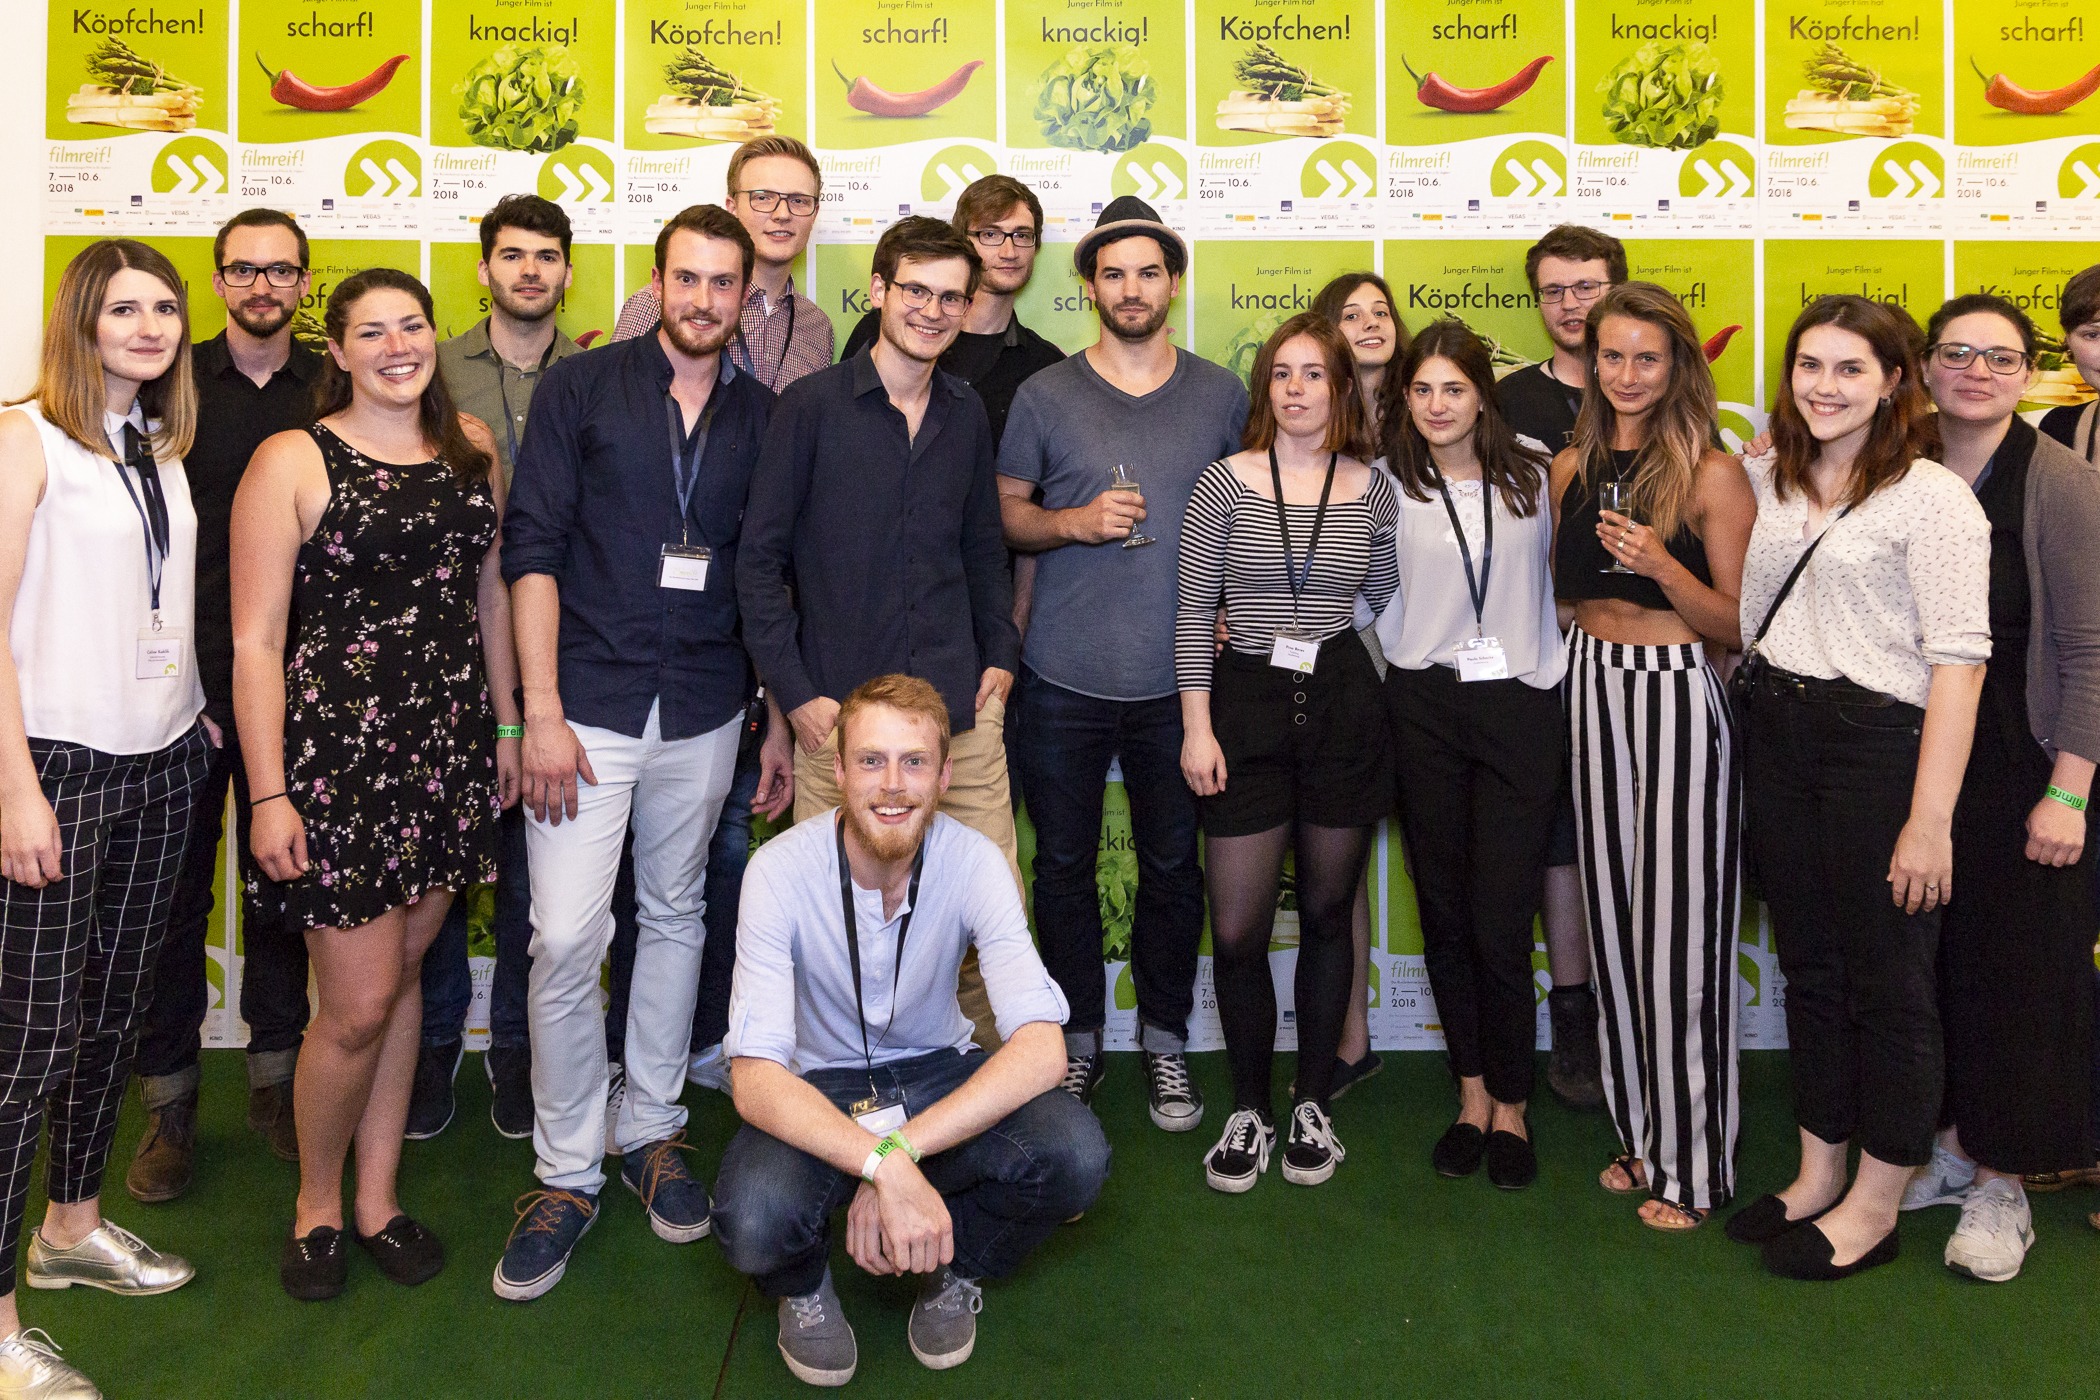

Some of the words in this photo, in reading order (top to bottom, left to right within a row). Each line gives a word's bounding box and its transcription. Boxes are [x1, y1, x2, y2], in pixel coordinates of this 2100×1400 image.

[685, 2, 711, 11] Junger
[713, 2, 731, 10] Film
[733, 2, 746, 10] hat
[877, 1, 903, 10] Junger
[905, 1, 923, 9] Film
[1067, 0, 1093, 9] Junger
[73, 8, 204, 34] Köpfchen!
[287, 11, 373, 37] scharf!
[1220, 14, 1350, 41] Köpfchen!
[1432, 13, 1517, 39] scharf!
[1611, 13, 1717, 44] knackig!
[1789, 14, 1919, 41] Köpfchen!
[2000, 15, 2083, 41] scharf!
[469, 14, 577, 47] knackig!
[650, 18, 781, 45] Köpfchen!
[862, 17, 948, 43] scharf!
[1042, 16, 1148, 47] knackig!
[49, 146, 112, 164] filmreif!
[241, 150, 305, 167] filmreif!
[433, 153, 497, 171] filmreif!
[1009, 154, 1072, 171] filmreif!
[1199, 152, 1262, 169] filmreif!
[1388, 151, 1451, 169] filmreif!
[1577, 151, 1639, 168] filmreif!
[1767, 151, 1830, 169] filmreif!
[627, 156, 691, 174] filmreif!
[49, 184, 74, 193] 2018
[241, 187, 267, 196] 2018
[432, 191, 459, 200] 2018
[1199, 190, 1225, 199] 2018
[1389, 189, 1414, 198] 2018
[1577, 188, 1602, 197] 2018
[1767, 188, 1793, 198] 2018
[1956, 189, 1982, 198] 2018
[627, 194, 653, 203] 2018
[819, 193, 844, 202] 2018
[327, 265, 344, 274] Film
[1256, 266, 1283, 276] Junger
[1284, 266, 1302, 275] Film
[1303, 267, 1312, 275] ist
[1443, 265, 1470, 275] Junger
[1471, 265, 1489, 274] Film
[1490, 265, 1504, 274] hat
[1636, 265, 1662, 275] Junger
[1664, 265, 1682, 273] Film
[1683, 265, 1692, 273] ist
[1826, 266, 1853, 275] Junger
[1854, 265, 1872, 274] Film
[1873, 266, 1882, 274] ist
[2014, 267, 2040, 276] Junger
[2041, 266, 2060, 275] Film
[2060, 267, 2074, 275] hat
[1231, 283, 1312, 309] knacki
[1409, 282, 1539, 309] Köpfchen!
[1391, 998, 1416, 1008] 2018
